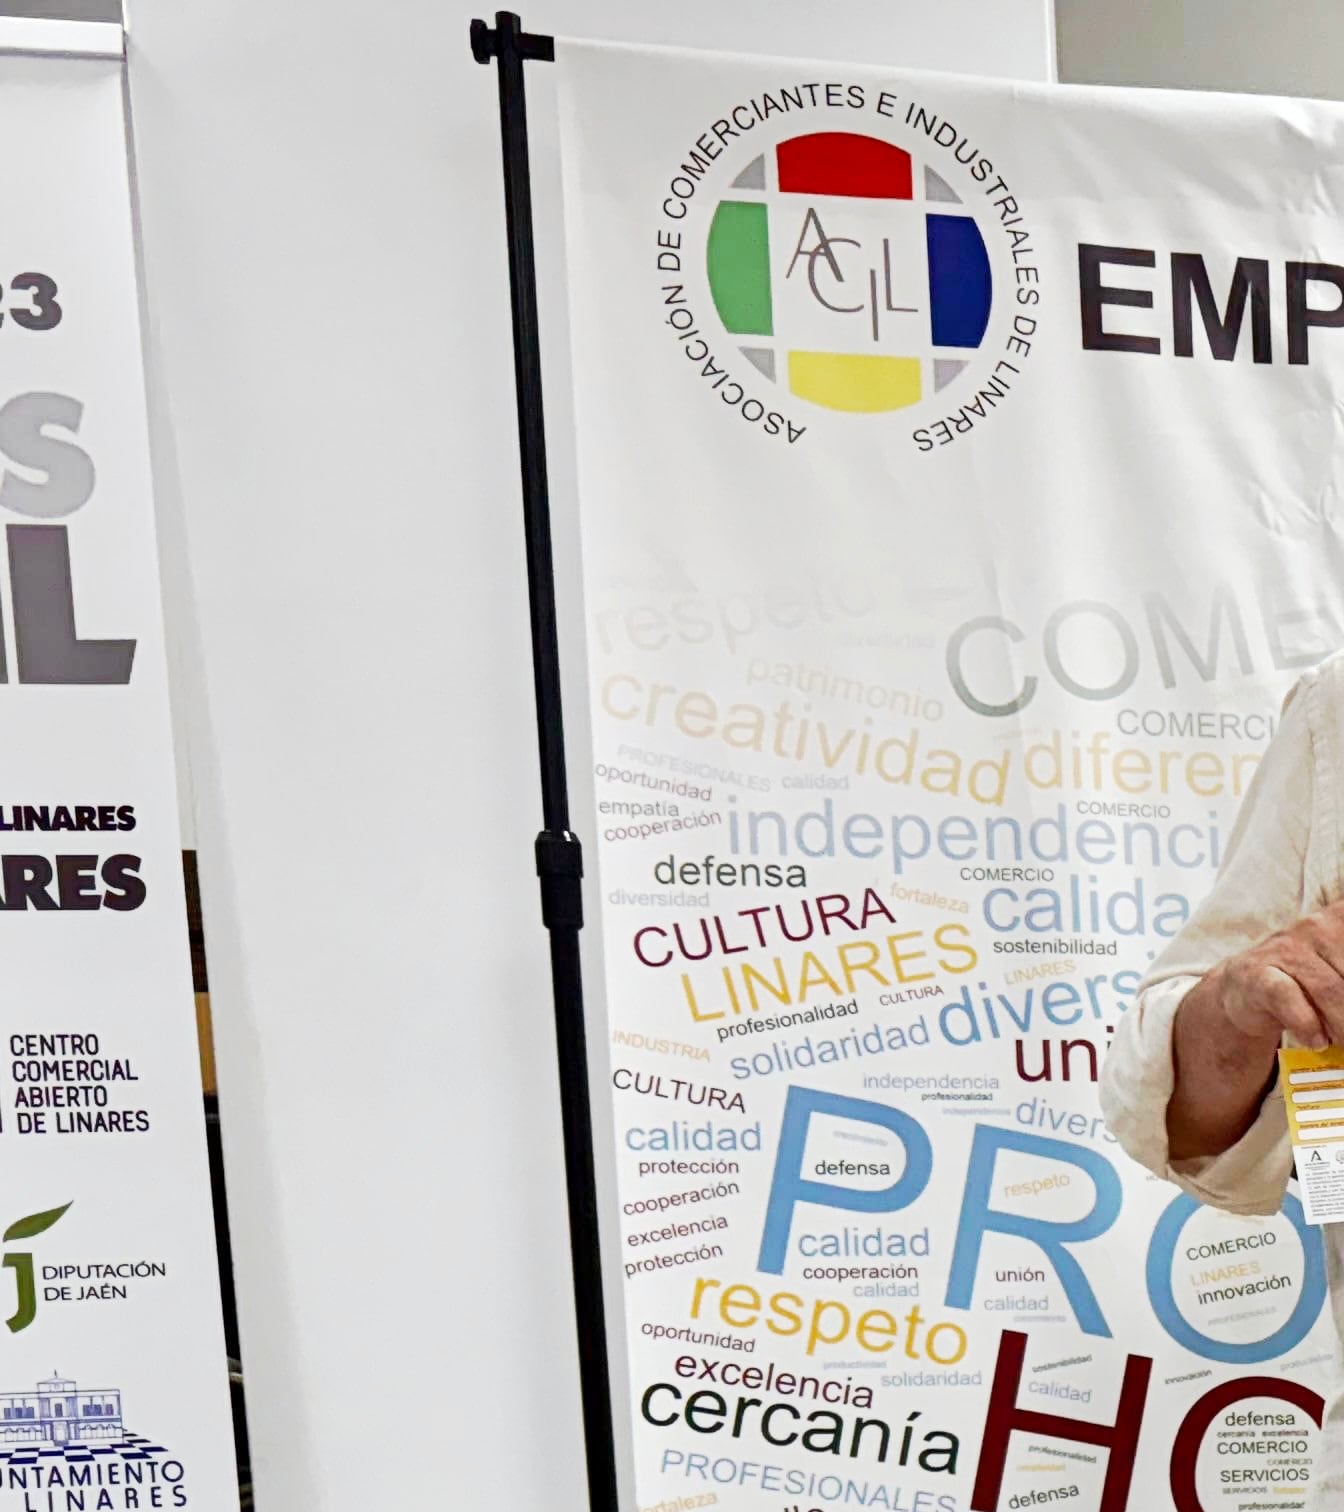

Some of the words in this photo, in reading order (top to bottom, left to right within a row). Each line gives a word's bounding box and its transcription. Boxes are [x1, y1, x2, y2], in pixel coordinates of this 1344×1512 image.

[662, 83, 866, 221] COMERCIANTES
[904, 102, 1040, 307] INDUSTRIALES
[663, 283, 807, 445] ASOCIACIÓN
[745, 657, 944, 723] patrimonio
[600, 671, 1011, 806] creatividad
[595, 763, 713, 801] oportunidad
[599, 799, 680, 820] empatía
[603, 810, 722, 843] cooperación
[0, 854, 146, 911] RES
[654, 854, 807, 888] defensa
[960, 867, 1055, 882] COMERCIO
[608, 889, 711, 909] diversidad
[983, 873, 1190, 938] calida
[633, 887, 897, 968] CULTURA
[993, 938, 1118, 956] sostenibilidad
[681, 923, 978, 1022] LINARES
[716, 998, 859, 1043] profesionalidad
[10, 1033, 99, 1057] CENTRO
[613, 1029, 711, 1063] INDUSTRIA
[730, 1014, 930, 1081] solidaridad
[12, 1059, 138, 1082] COMERCIAL
[863, 1073, 1000, 1092] independencia
[15, 1085, 107, 1108] ABIERTO
[612, 1067, 747, 1114] CULTURA
[17, 1112, 46, 1133] DE
[56, 1110, 149, 1133] LINARES
[625, 1121, 762, 1152] calidad
[638, 1158, 740, 1178] protección
[815, 1160, 891, 1177] defensa
[623, 1180, 740, 1217] cooperación
[1003, 1172, 1072, 1200] respeto
[627, 1214, 729, 1249] excelencia
[799, 1227, 930, 1258] calidad
[1186, 1231, 1277, 1263] COMERCIO
[42, 1260, 166, 1281] DIPUTACIÓN
[624, 1243, 724, 1280] protección
[802, 1265, 919, 1282] cooperación
[44, 1286, 72, 1301] DE
[76, 1282, 127, 1301] JAÉN
[689, 1275, 970, 1366] respeto
[641, 1321, 756, 1354] oportunidad
[674, 1355, 875, 1410] excelencia
[640, 1382, 961, 1476] cercanía
[0, 1460, 184, 1490] NTAMIENTO
[1220, 1468, 1310, 1483] SERVICIOS
